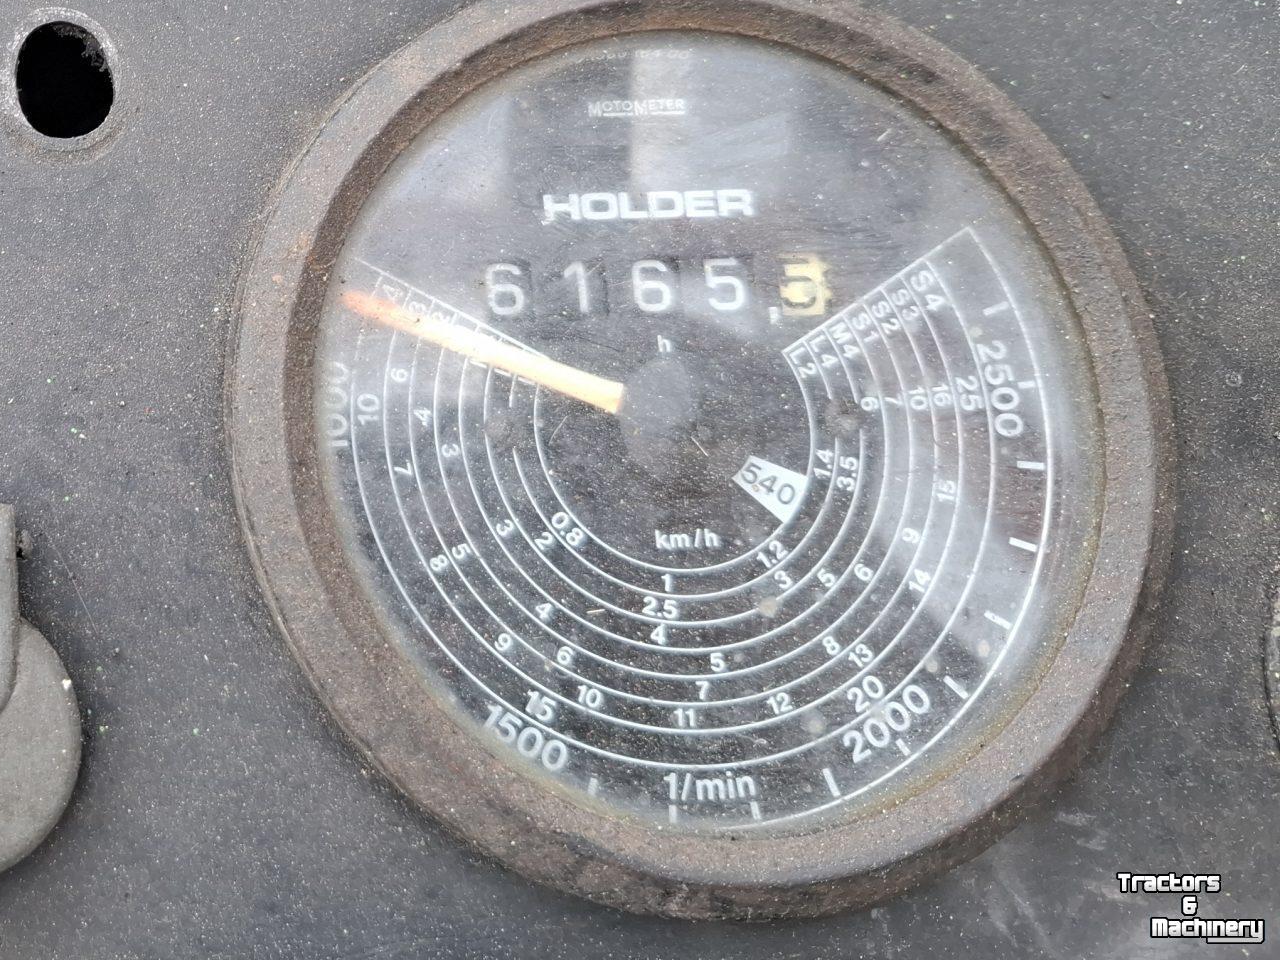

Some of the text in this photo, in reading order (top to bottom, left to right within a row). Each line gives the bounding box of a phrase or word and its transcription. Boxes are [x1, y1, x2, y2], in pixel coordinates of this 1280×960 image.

[587, 97, 686, 117] MOTOMETER
[542, 188, 757, 222] HOLDER
[809, 335, 838, 369] L4
[829, 322, 861, 360] M4
[788, 347, 817, 379] L2
[909, 387, 928, 411] 10
[955, 376, 984, 411] 25
[976, 340, 1024, 437] 2500
[356, 393, 380, 426] 10
[813, 448, 834, 480] 1.4
[836, 455, 859, 492] 3.5
[740, 462, 796, 505] 540
[495, 519, 514, 537] 3
[551, 510, 584, 547] 0.8
[654, 528, 721, 550] km/h
[452, 543, 471, 560] 5
[534, 532, 553, 551] 2
[429, 554, 449, 572] 8
[756, 540, 789, 568] 1.2
[774, 570, 793, 590] 3
[817, 569, 837, 588] 5
[535, 601, 554, 621] 4
[641, 595, 680, 619] 2.5
[650, 624, 668, 646] 4
[822, 636, 841, 656] 8
[710, 652, 726, 673] 5
[848, 643, 874, 668] 13
[576, 684, 603, 708] 10
[695, 680, 710, 701] 7
[846, 675, 885, 713] 20
[525, 689, 557, 722] 15
[766, 691, 793, 715] 12
[673, 708, 696, 728] 11
[842, 684, 931, 764] 2000
[483, 703, 569, 771] 1500
[663, 771, 756, 801] 1/min
